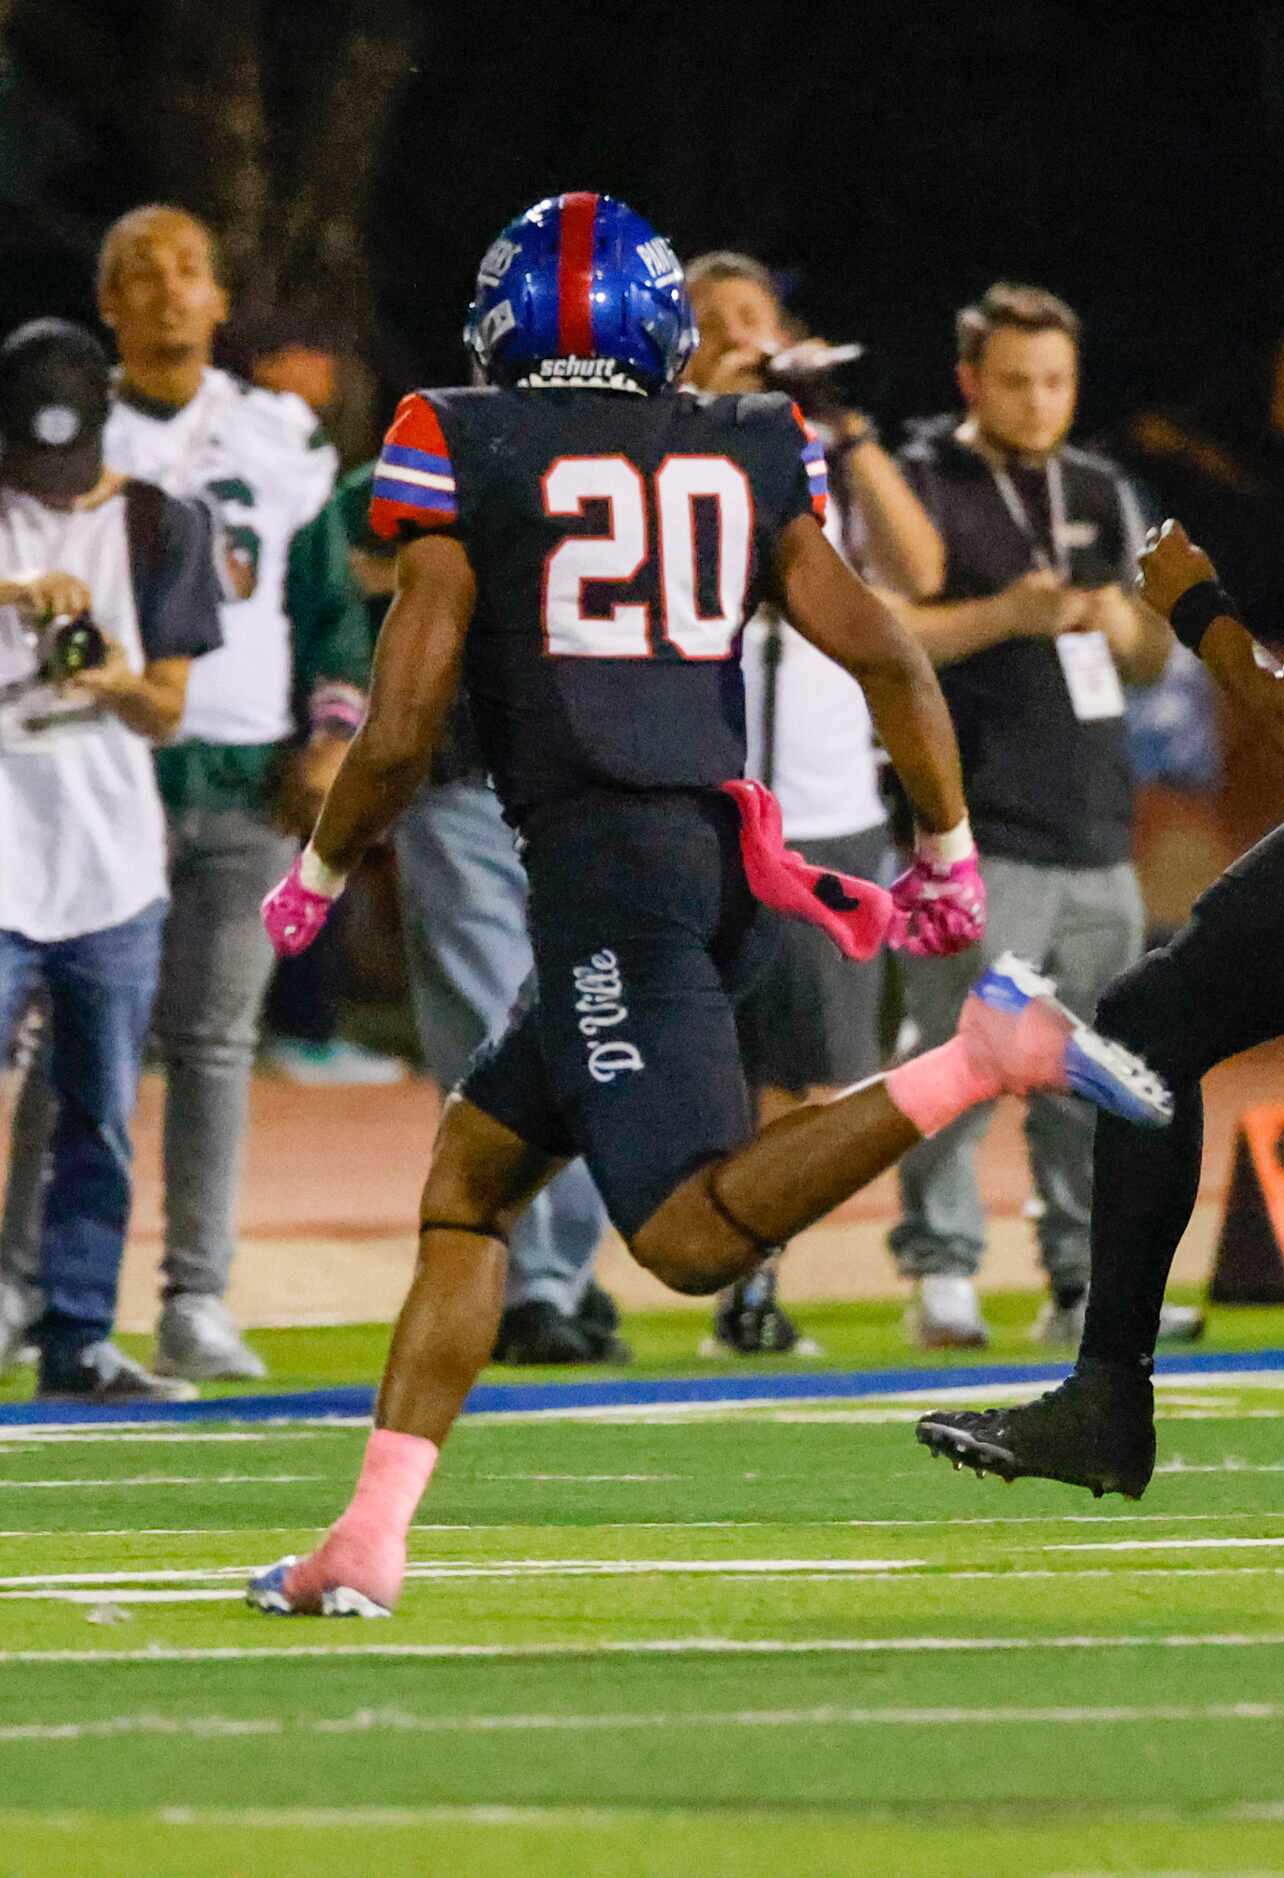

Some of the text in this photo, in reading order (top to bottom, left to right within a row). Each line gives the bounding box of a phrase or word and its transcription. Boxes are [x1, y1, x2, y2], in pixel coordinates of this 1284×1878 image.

[540, 354, 616, 377] schutt
[540, 454, 756, 661] 20
[573, 949, 645, 1082] D'Ville
